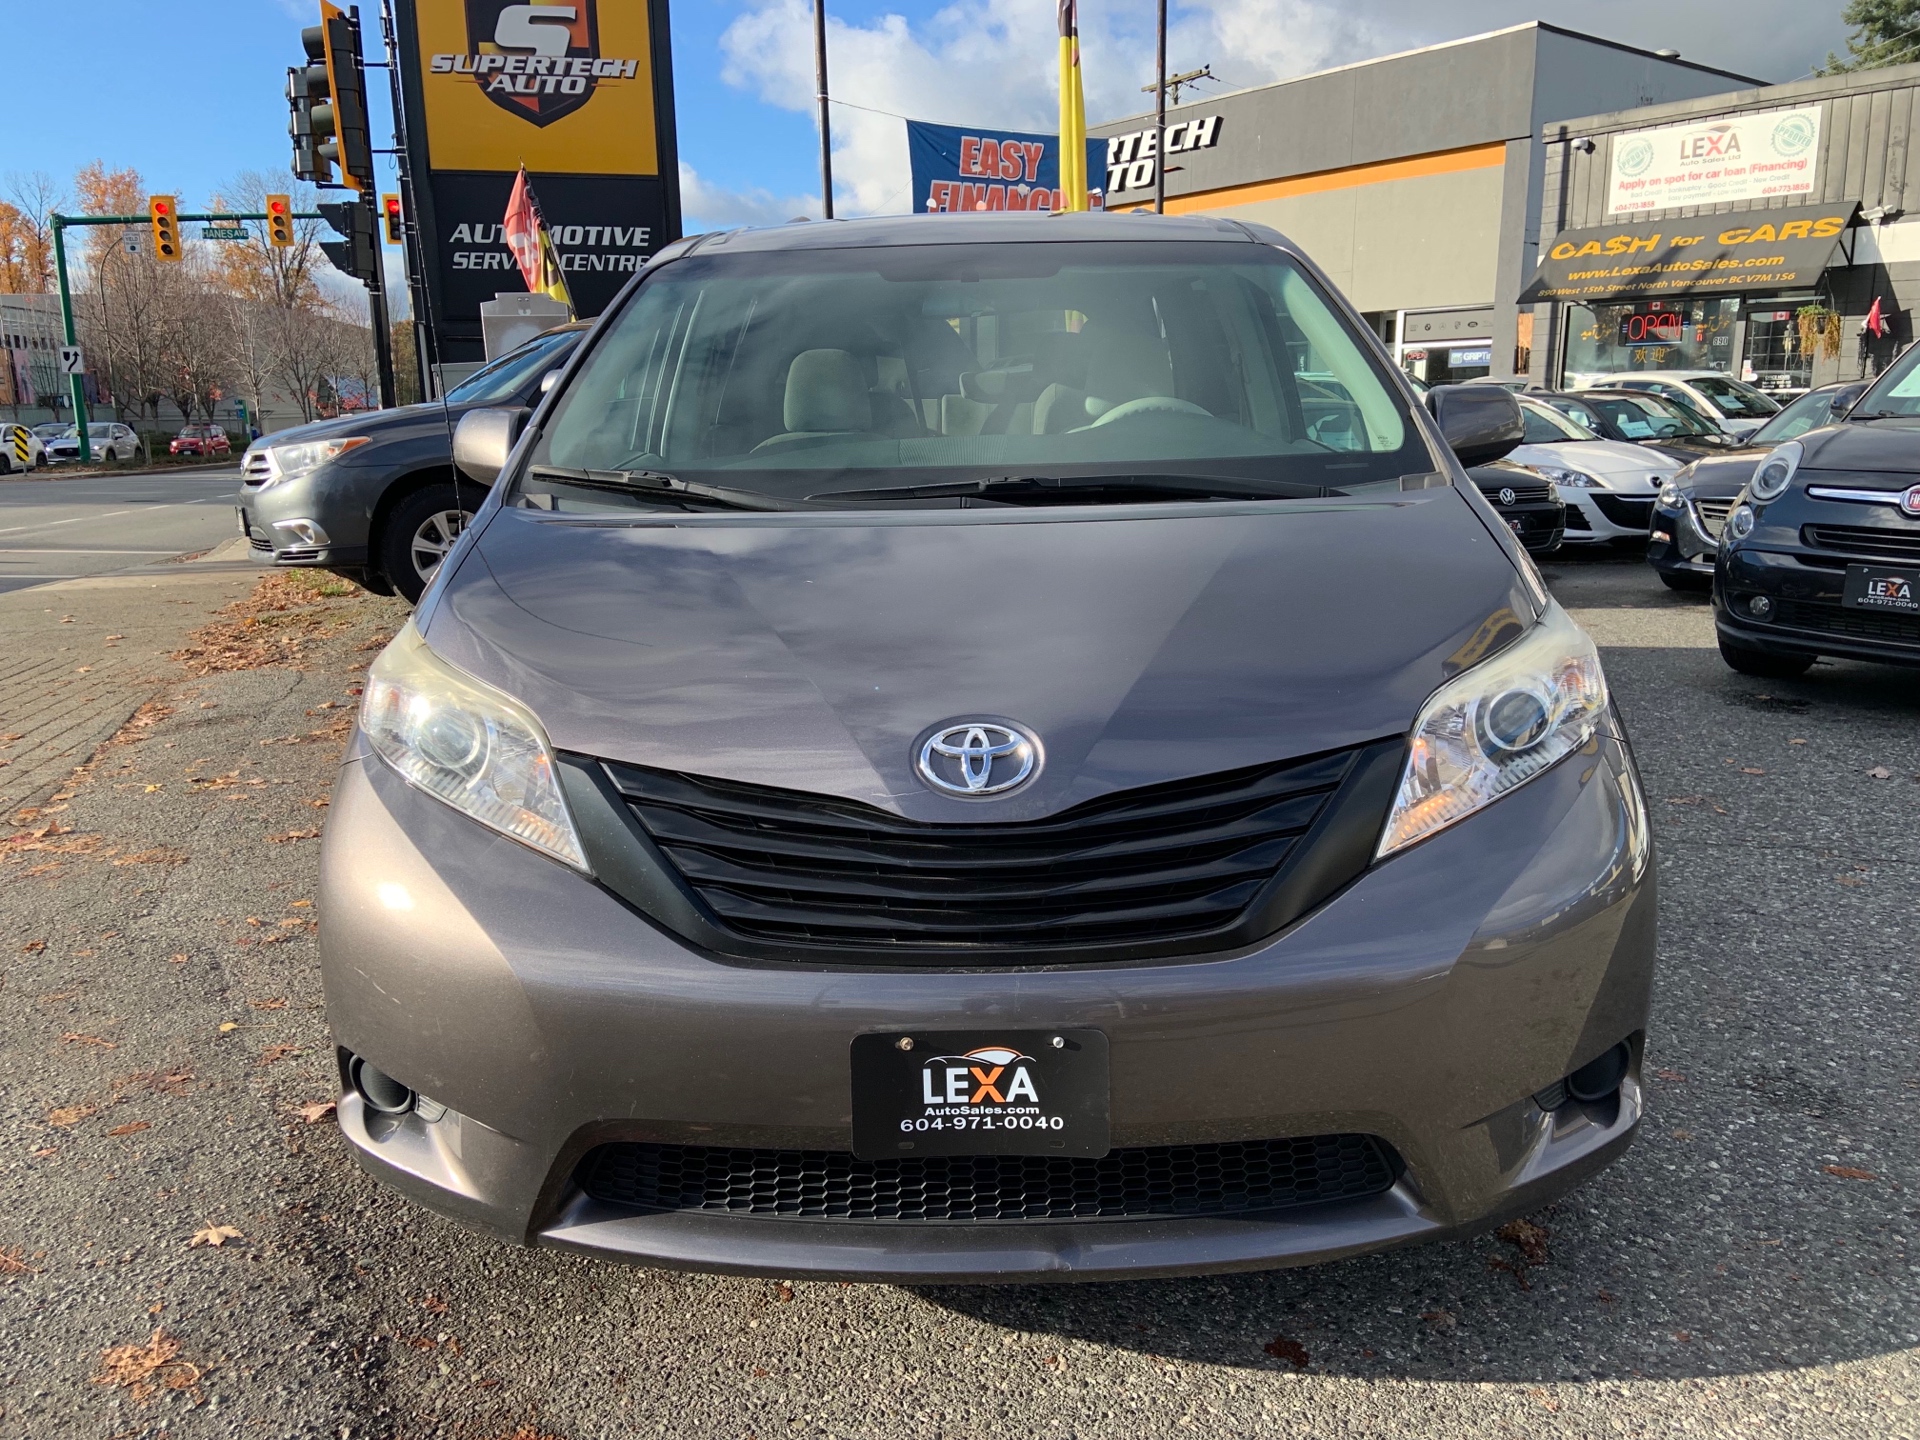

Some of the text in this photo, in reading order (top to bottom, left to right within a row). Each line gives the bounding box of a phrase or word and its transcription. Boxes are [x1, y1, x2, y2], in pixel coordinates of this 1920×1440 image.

[430, 53, 639, 80] SUPERTECH
[487, 75, 587, 95] AUTO
[1774, 123, 1813, 148] APPROVED
[1680, 133, 1741, 160] LEXA
[959, 135, 1044, 182] EASY
[1680, 160, 1699, 168] Auto
[1702, 156, 1726, 164] Sales
[1618, 158, 1807, 190] Apply on spot for car loan (Financing)
[928, 180, 1103, 213] FINANCI
[1631, 190, 1643, 199] Bad
[1644, 188, 1663, 197] Credit
[1708, 181, 1727, 190] Good
[1729, 178, 1748, 187] Credit
[1753, 176, 1768, 185] New
[1770, 174, 1790, 182] Credit
[1668, 194, 1682, 203] Easy
[1683, 190, 1712, 201] payment
[1718, 188, 1730, 196] Low
[1762, 183, 1810, 195] 604-773-1858
[1615, 201, 1656, 212] 604-773-1858
[202, 229, 248, 239] HANES AVE
[449, 223, 651, 247] AUTMOTIVE
[1670, 235, 1704, 247] for
[1718, 217, 1845, 245] CARS
[452, 251, 521, 271] SERV
[1568, 254, 1785, 281] www.LexaAutoSales.com
[1538, 289, 1556, 297] 890
[1557, 286, 1581, 296] West
[1583, 284, 1605, 294] 15th
[1606, 281, 1636, 293] Street
[1638, 279, 1669, 290] North
[1671, 275, 1727, 288] Vancouver
[1730, 274, 1746, 284] BC
[1748, 273, 1772, 283] V7M
[1628, 313, 1683, 341] OPEN
[1713, 337, 1728, 346] 890
[1407, 351, 1427, 360] OPEN
[1633, 346, 1666, 364] 欢迎
[1508, 522, 1522, 530] EXA
[1867, 580, 1911, 599] LEXA
[1857, 597, 1919, 609] 604-971-0040
[922, 1066, 1039, 1104] LEXA
[924, 1105, 1040, 1116] AutoSales.com
[900, 1116, 1064, 1132] 604-971-0040
